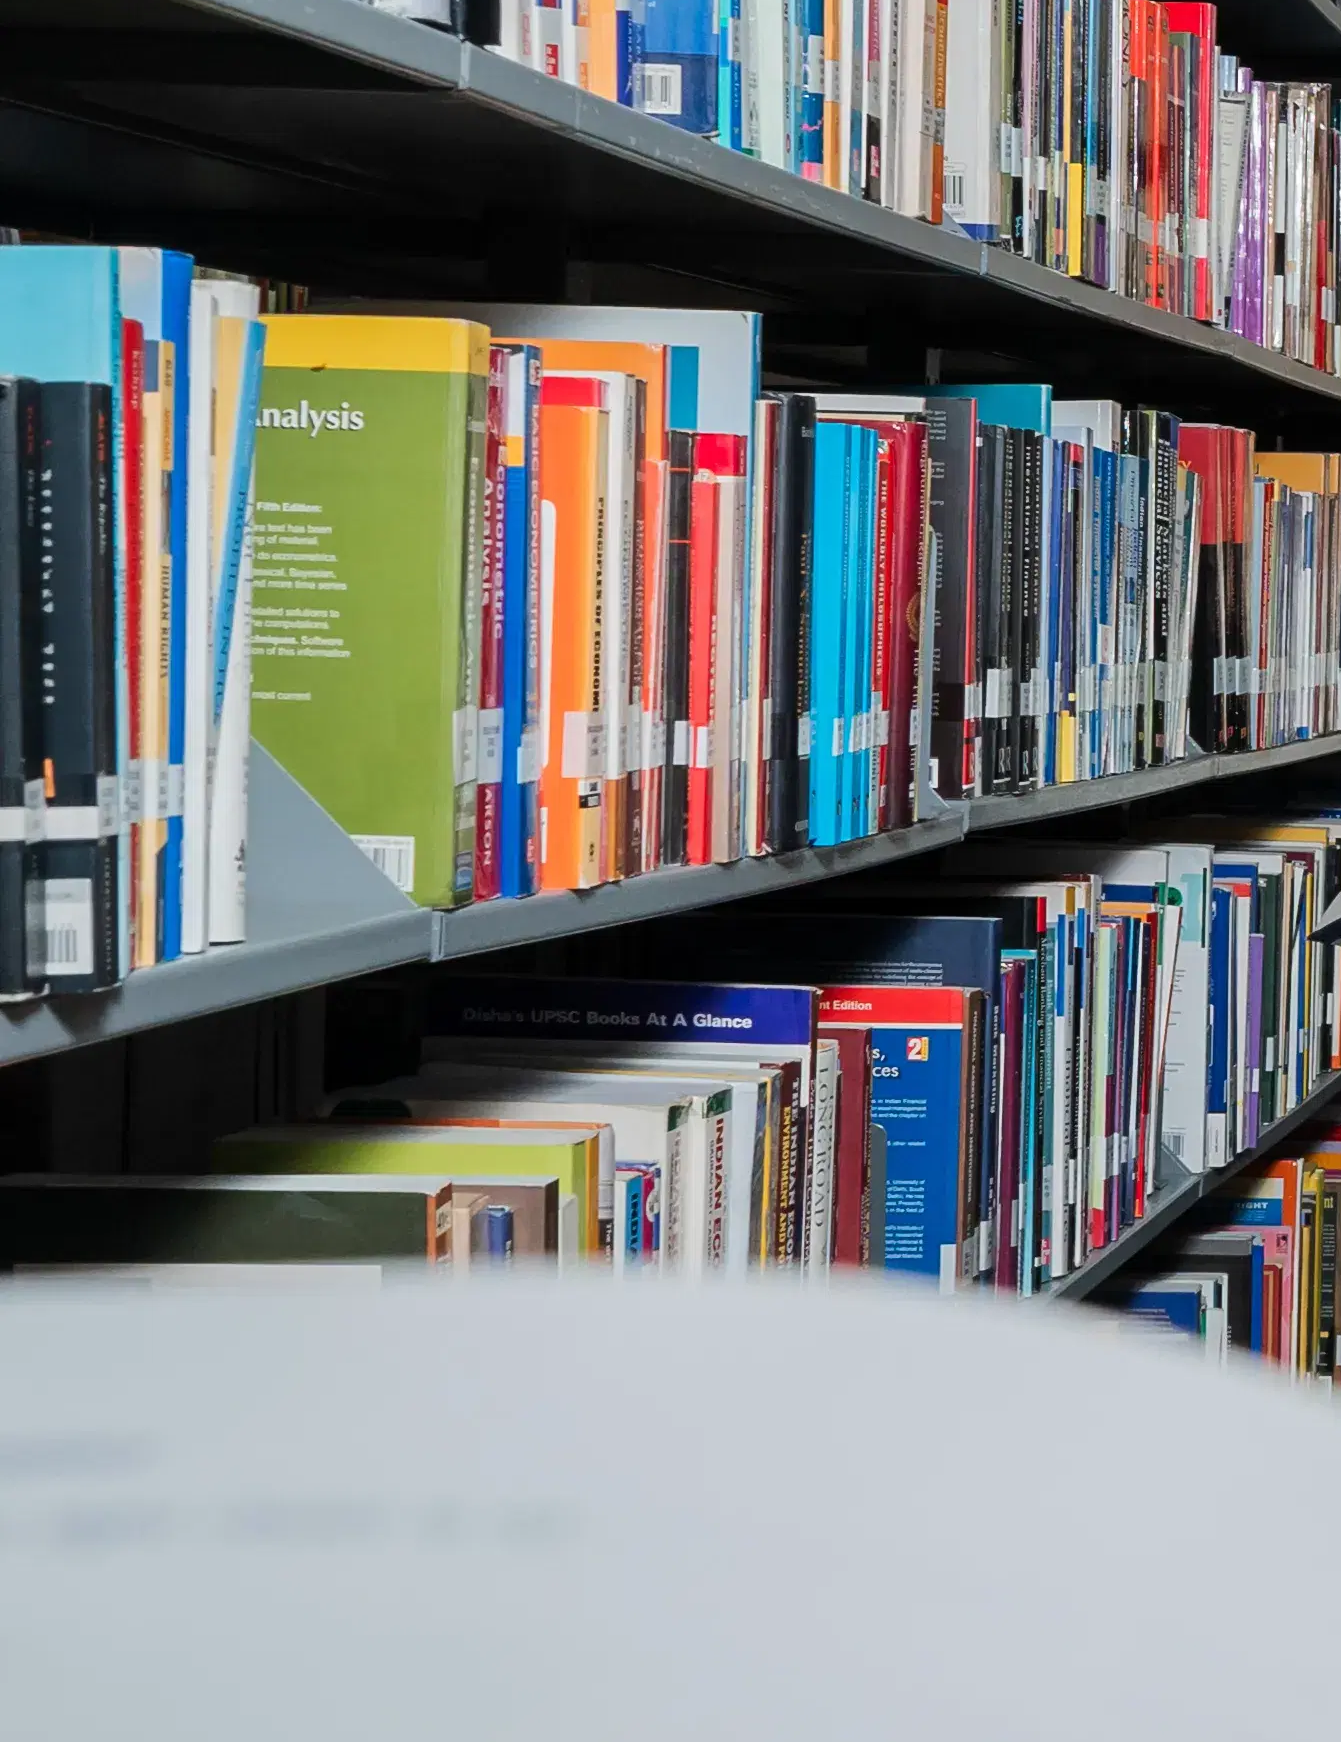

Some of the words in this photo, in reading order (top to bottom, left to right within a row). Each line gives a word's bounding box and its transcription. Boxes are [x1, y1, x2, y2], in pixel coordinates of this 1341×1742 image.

[481, 475, 494, 605] Analysis
[492, 444, 507, 640] Econometric
[531, 1010, 580, 1025] UPSC
[586, 1011, 640, 1026] Books
[646, 1012, 668, 1027] At
[673, 1013, 688, 1027] A
[694, 1014, 753, 1029] Glance
[833, 1000, 873, 1011] Edition
[908, 1038, 922, 1061] 2
[791, 1078, 800, 1110] THE
[714, 1118, 725, 1210] INDIAN
[780, 1106, 792, 1207] ENVIRONMENT
[787, 1130, 799, 1205] INDIAN
[814, 1151, 827, 1227] ROAD
[779, 1213, 787, 1242] AND
